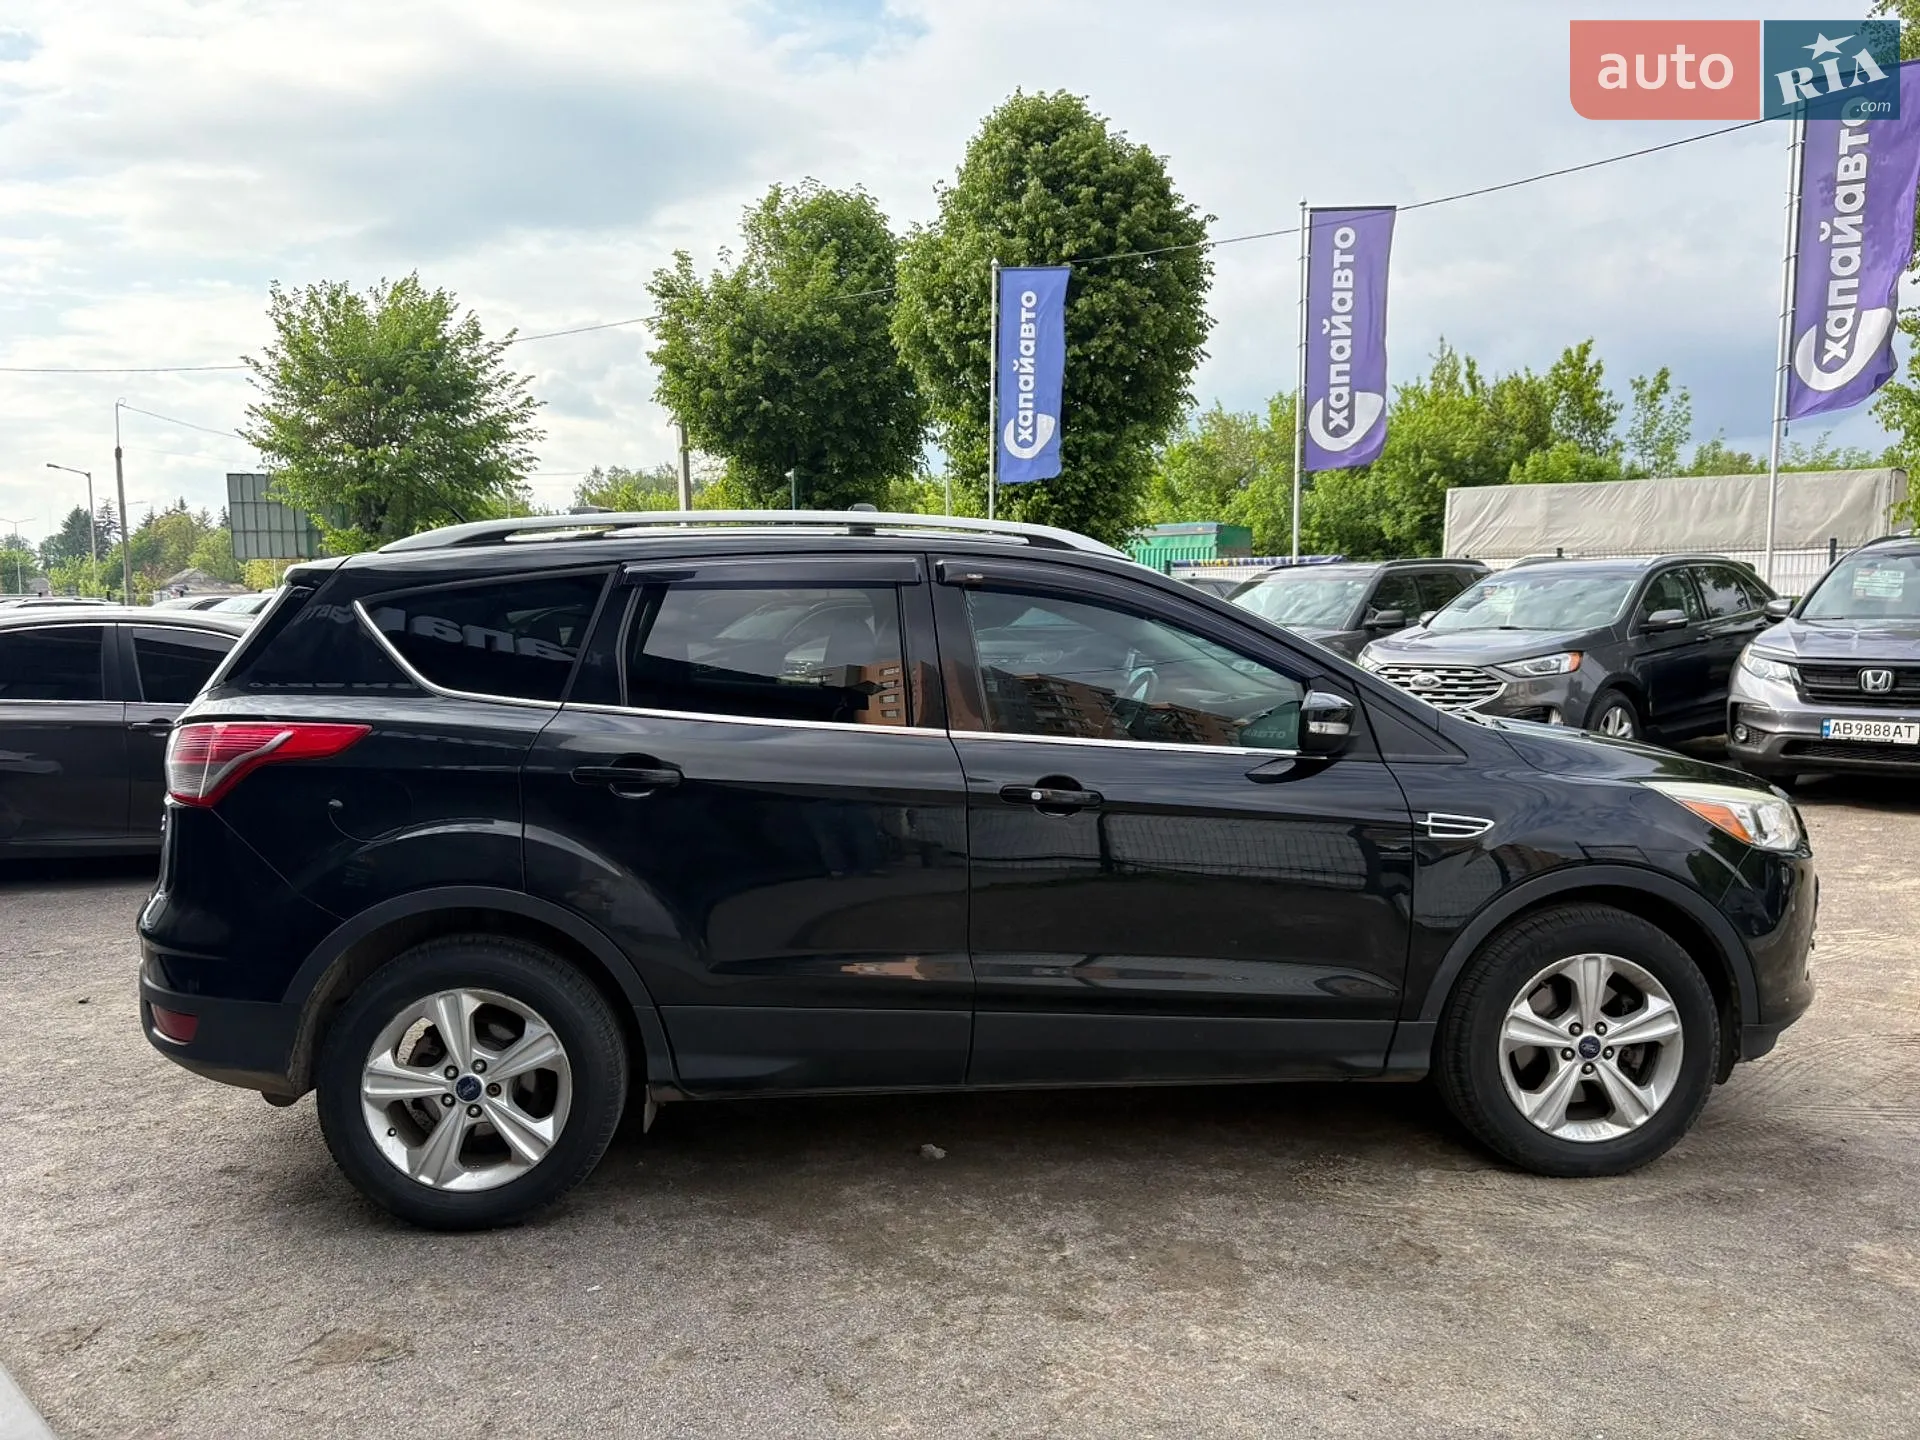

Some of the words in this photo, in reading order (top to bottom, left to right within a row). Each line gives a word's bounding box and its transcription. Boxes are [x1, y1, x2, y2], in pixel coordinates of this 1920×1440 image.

[1012, 290, 1038, 442] хапайавто
[1321, 226, 1357, 431] хапайавто
[1832, 722, 1916, 738] AB9888AT
